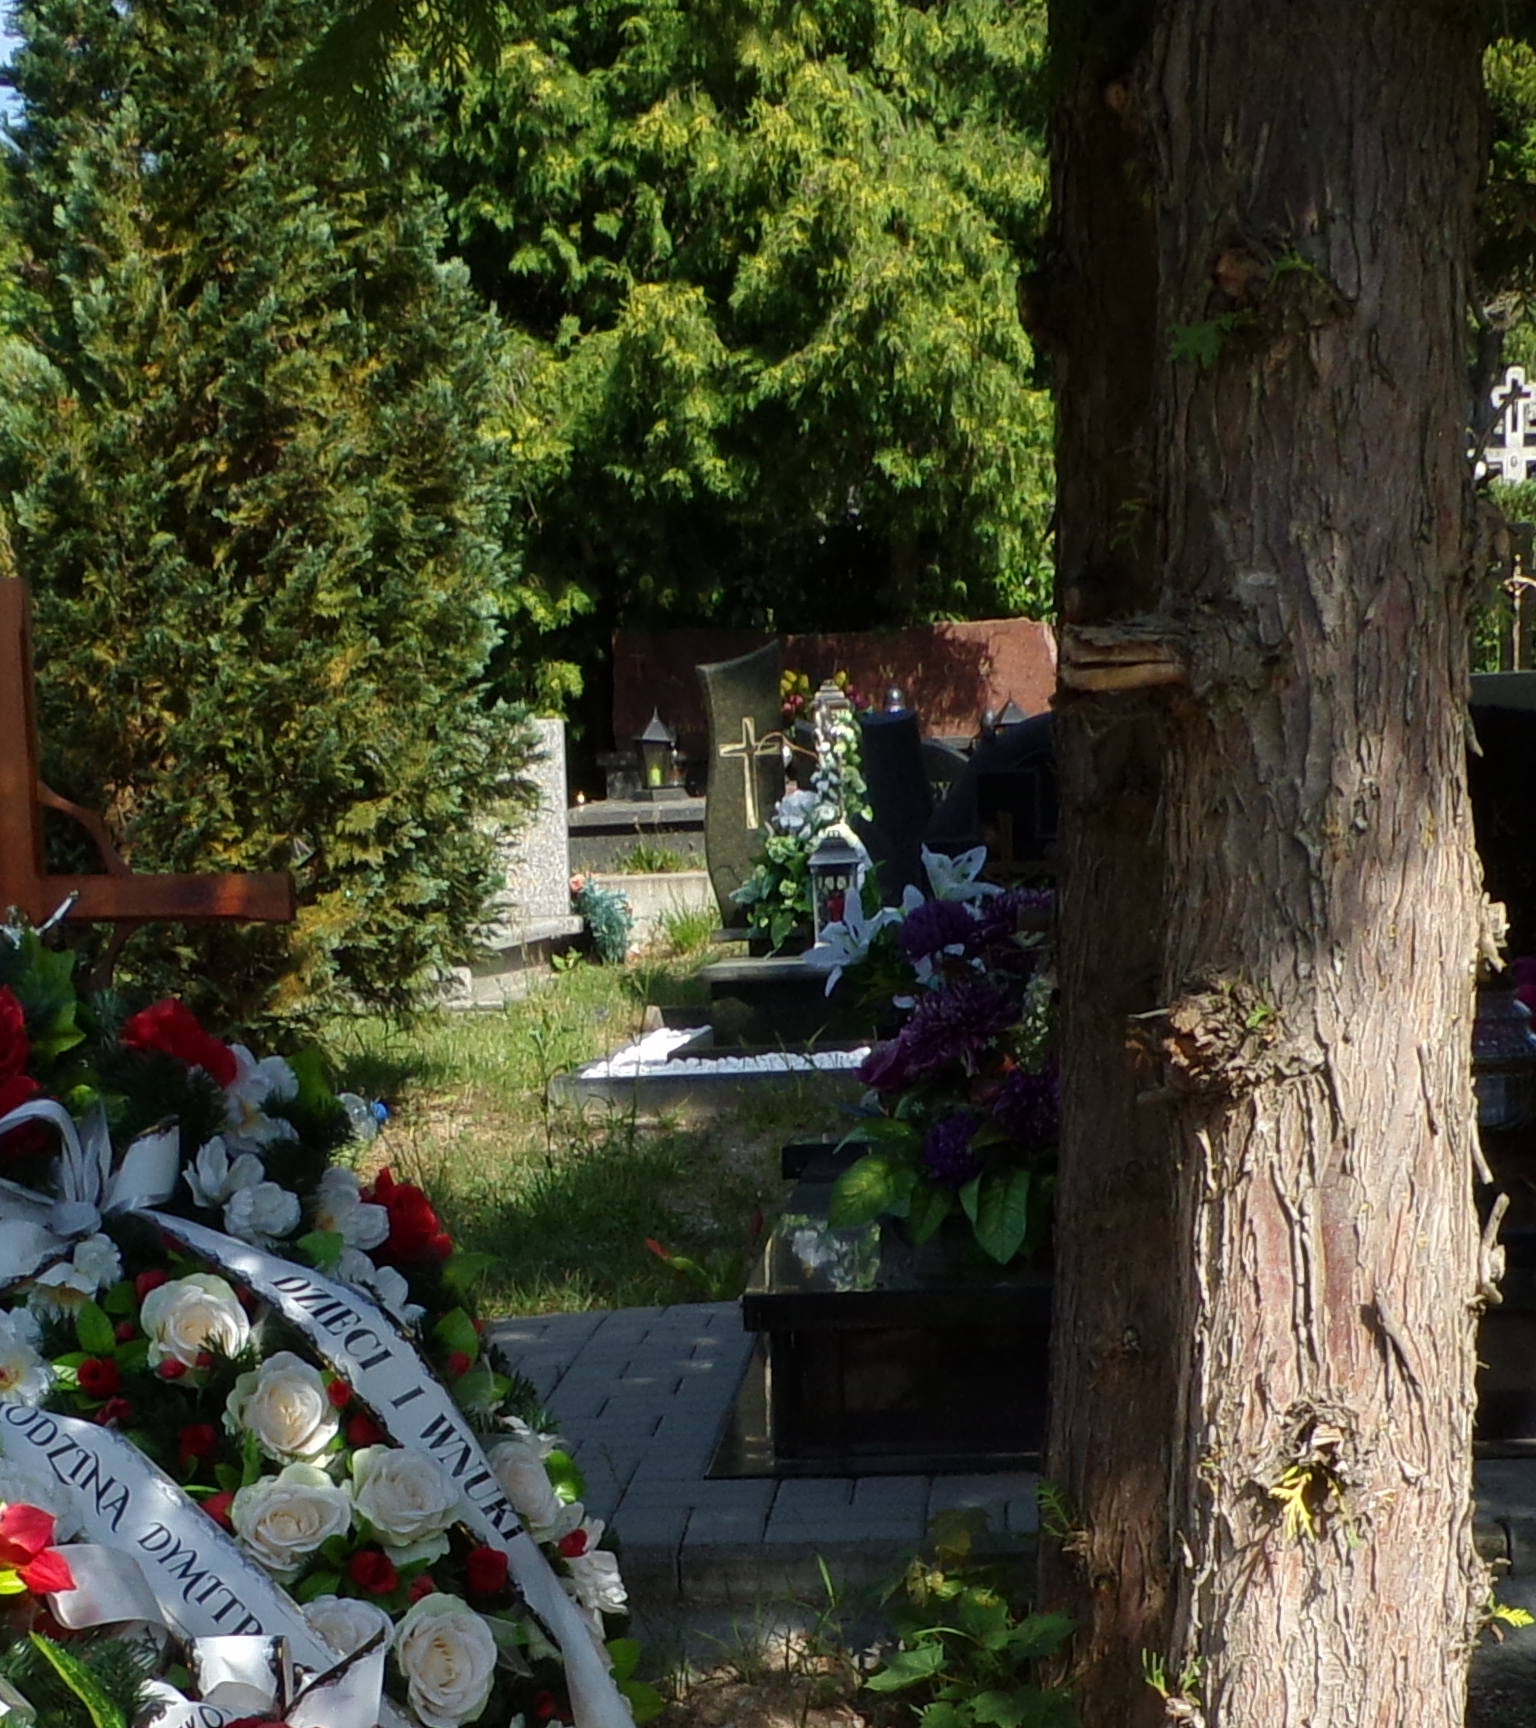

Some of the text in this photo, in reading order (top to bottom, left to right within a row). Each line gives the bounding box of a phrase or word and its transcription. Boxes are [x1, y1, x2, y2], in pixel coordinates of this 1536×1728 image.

[270, 1276, 525, 1543] DZIECI I WNUKI
